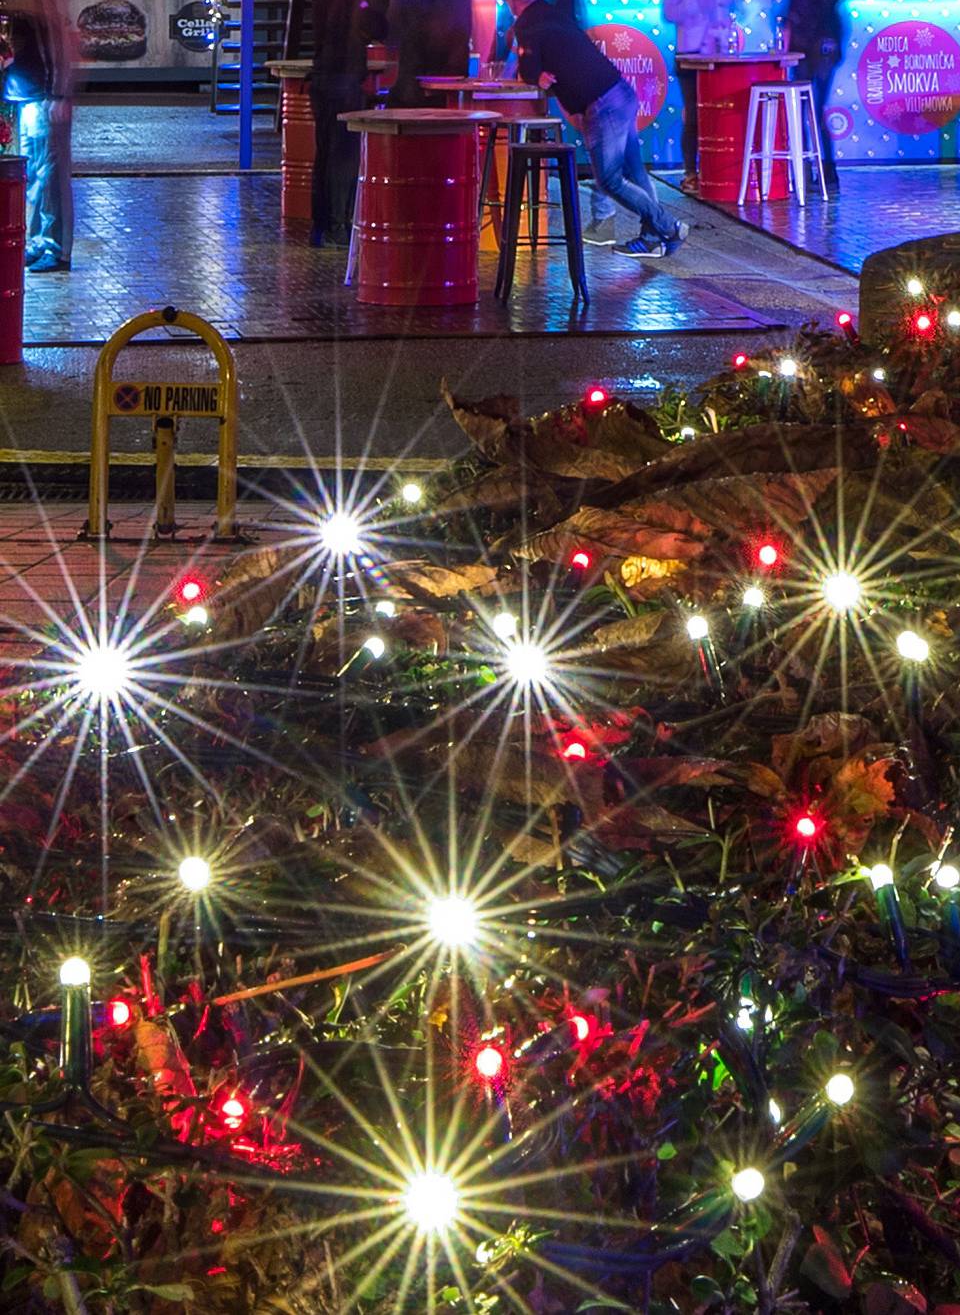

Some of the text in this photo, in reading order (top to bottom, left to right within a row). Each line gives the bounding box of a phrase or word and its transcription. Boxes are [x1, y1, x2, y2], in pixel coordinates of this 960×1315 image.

[877, 36, 909, 53] MEDICA
[904, 50, 955, 70] BOROVNIČKA
[866, 57, 884, 105] ORAHOVAC
[886, 70, 940, 94] SMOKVA
[144, 386, 219, 412] NO PARKING
